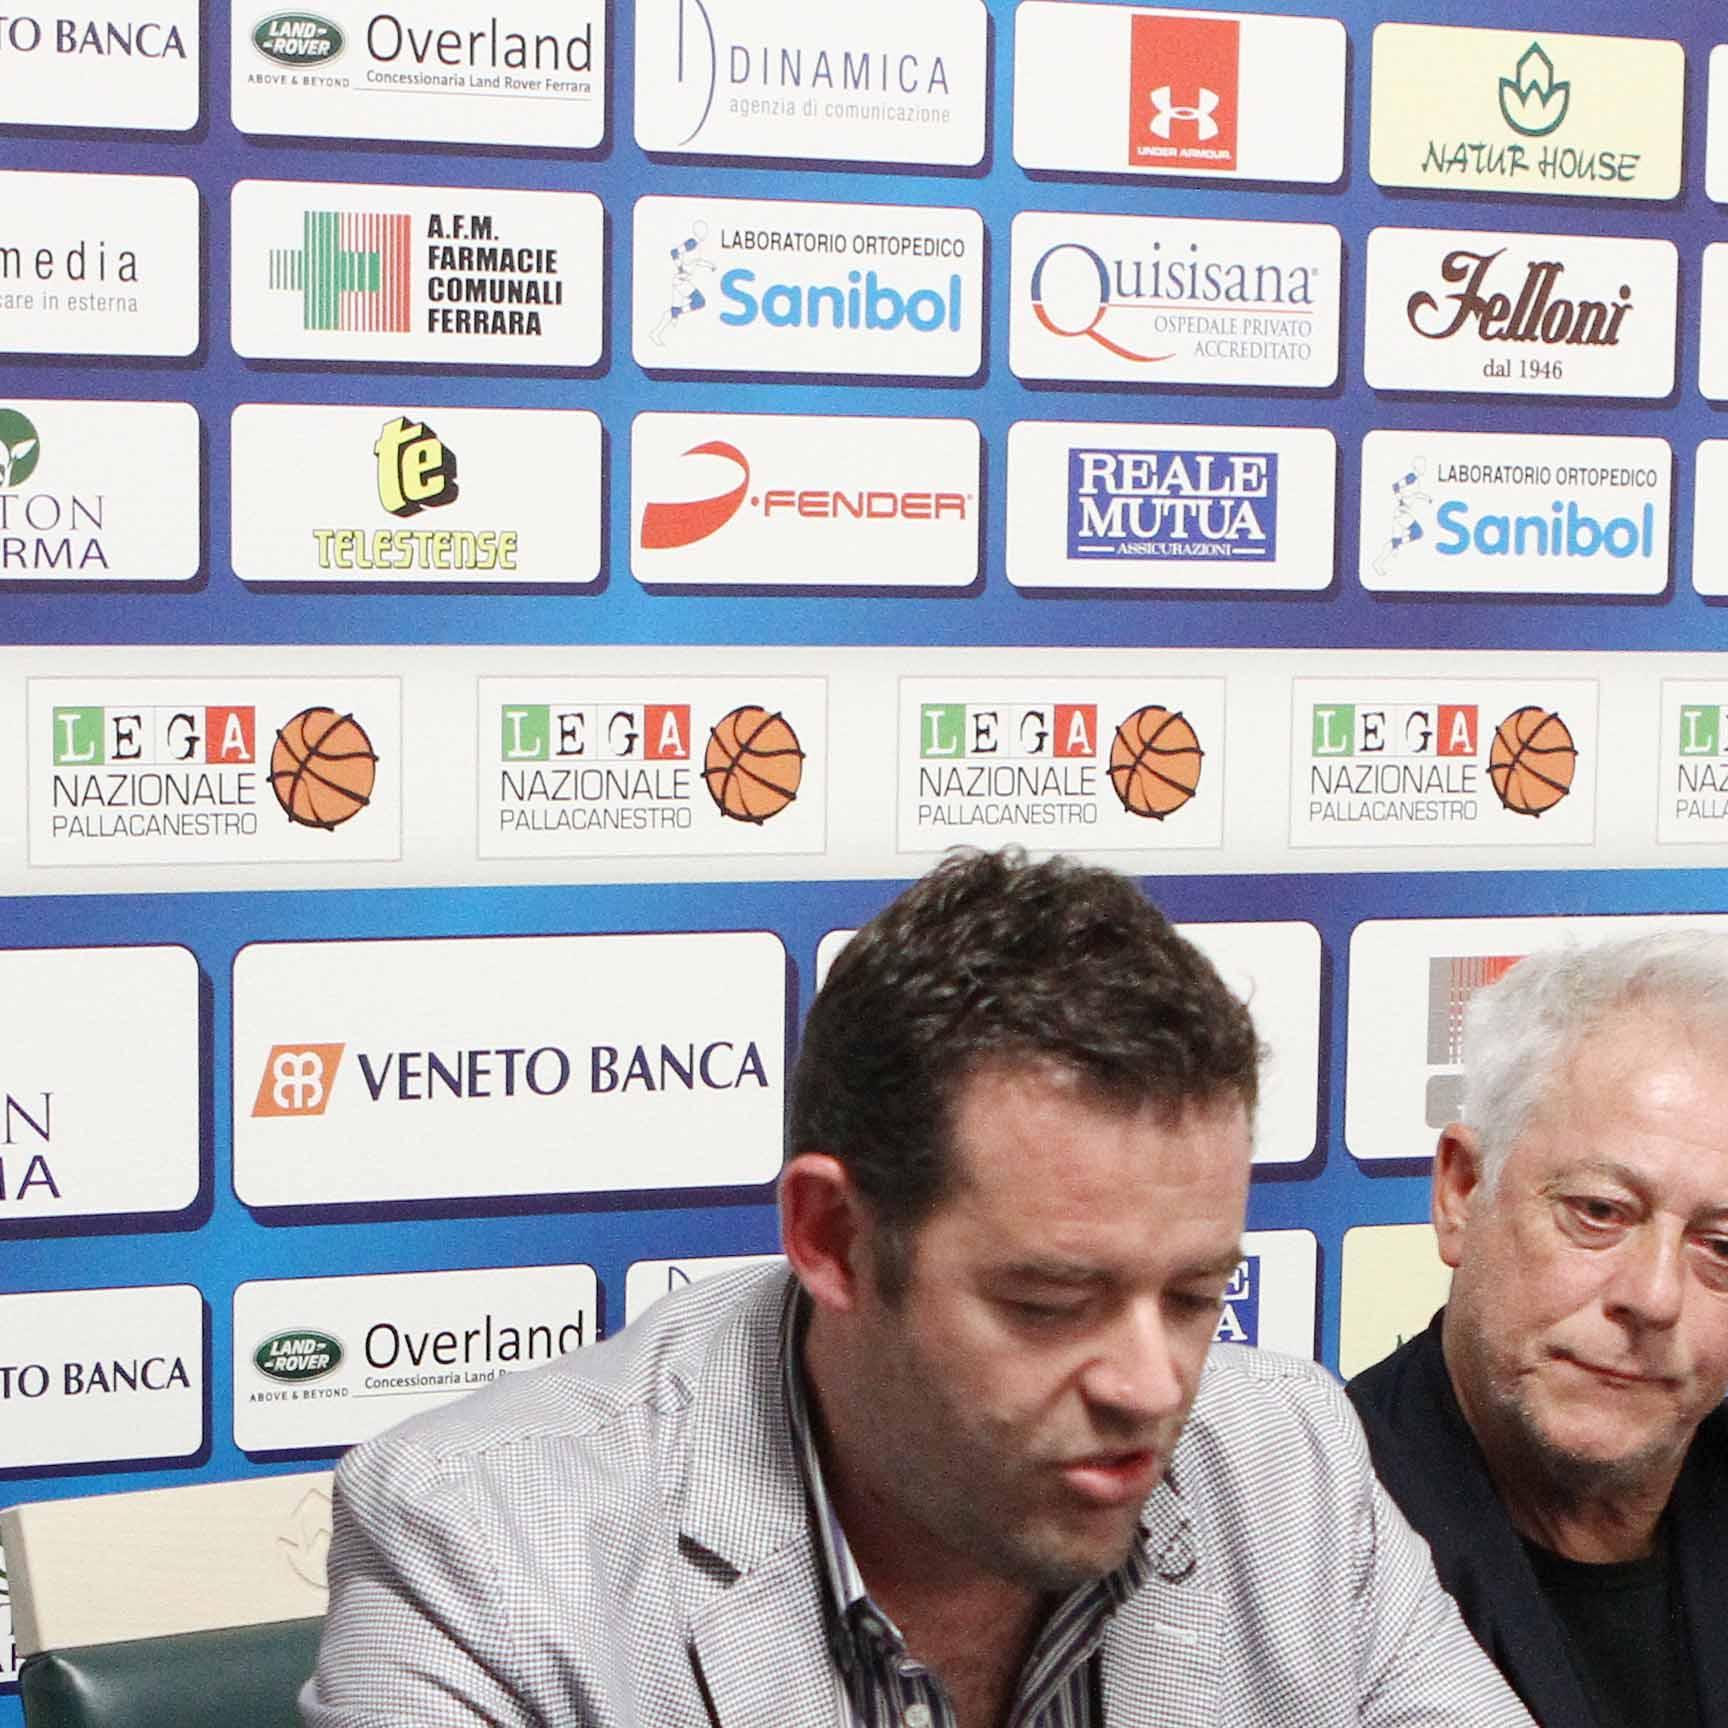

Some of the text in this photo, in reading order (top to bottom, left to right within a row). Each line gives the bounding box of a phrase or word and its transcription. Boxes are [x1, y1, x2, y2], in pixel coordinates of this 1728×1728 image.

[56, 19, 187, 59] BANCA
[366, 14, 592, 72] Overland
[248, 75, 350, 89] ABOVE BEYOND
[366, 71, 591, 94] Concessionaria Land Rover Ferrara
[730, 46, 951, 95] DINAMICA
[730, 98, 950, 124] agenzia di comunicazione
[1137, 146, 1177, 157] UNDER
[1422, 142, 1640, 181] NATUR HOUSE
[427, 213, 500, 240] A.F.M.
[720, 229, 965, 257] LABORATORIO ORTOPEDICO
[427, 247, 558, 274] FARMACIE
[43, 290, 59, 309] in
[66, 294, 138, 313] esterna
[427, 277, 563, 304] COMUNALI
[719, 268, 962, 332] Sanibol
[1031, 242, 1314, 362] Quisisana
[1407, 247, 1633, 346] Felloni
[427, 308, 542, 336] FERRARA
[1154, 315, 1312, 338] OSPEDALE PRIVATO
[1193, 340, 1312, 360] ACCREDITATO
[1483, 359, 1562, 379] dal 1946
[1078, 453, 1267, 497] REALE
[1438, 464, 1657, 486] LABORATORIO ORTOPEDICO
[1078, 496, 1266, 540] MUTUA
[1435, 499, 1654, 559] Sanibol
[313, 529, 518, 569] TELESTENSE
[1117, 542, 1232, 555] ASSICURAZIONI
[51, 706, 255, 765] LEGA
[501, 704, 690, 762] LEGA
[920, 703, 1097, 758] LEGA
[1312, 704, 1478, 757] LEGA
[52, 771, 256, 807] NAZIONALE
[502, 766, 690, 800] NAZIONALE
[919, 763, 1097, 797] NAZIONALE
[1310, 763, 1477, 794] NAZIONALE
[51, 811, 257, 839] PALLACANESTRO
[500, 805, 692, 832] PALLACANESTRO
[918, 802, 1098, 826] PALLACANESTRO
[1309, 799, 1478, 822] PALLACANESTRO
[358, 1040, 768, 1102] VENETO BANCA
[365, 1309, 584, 1369] Overland
[62, 1357, 190, 1394] BANCA
[365, 1372, 460, 1390] Concessionaria
[465, 1370, 494, 1384] Land
[250, 1387, 349, 1402] ABOVE BEYOND
